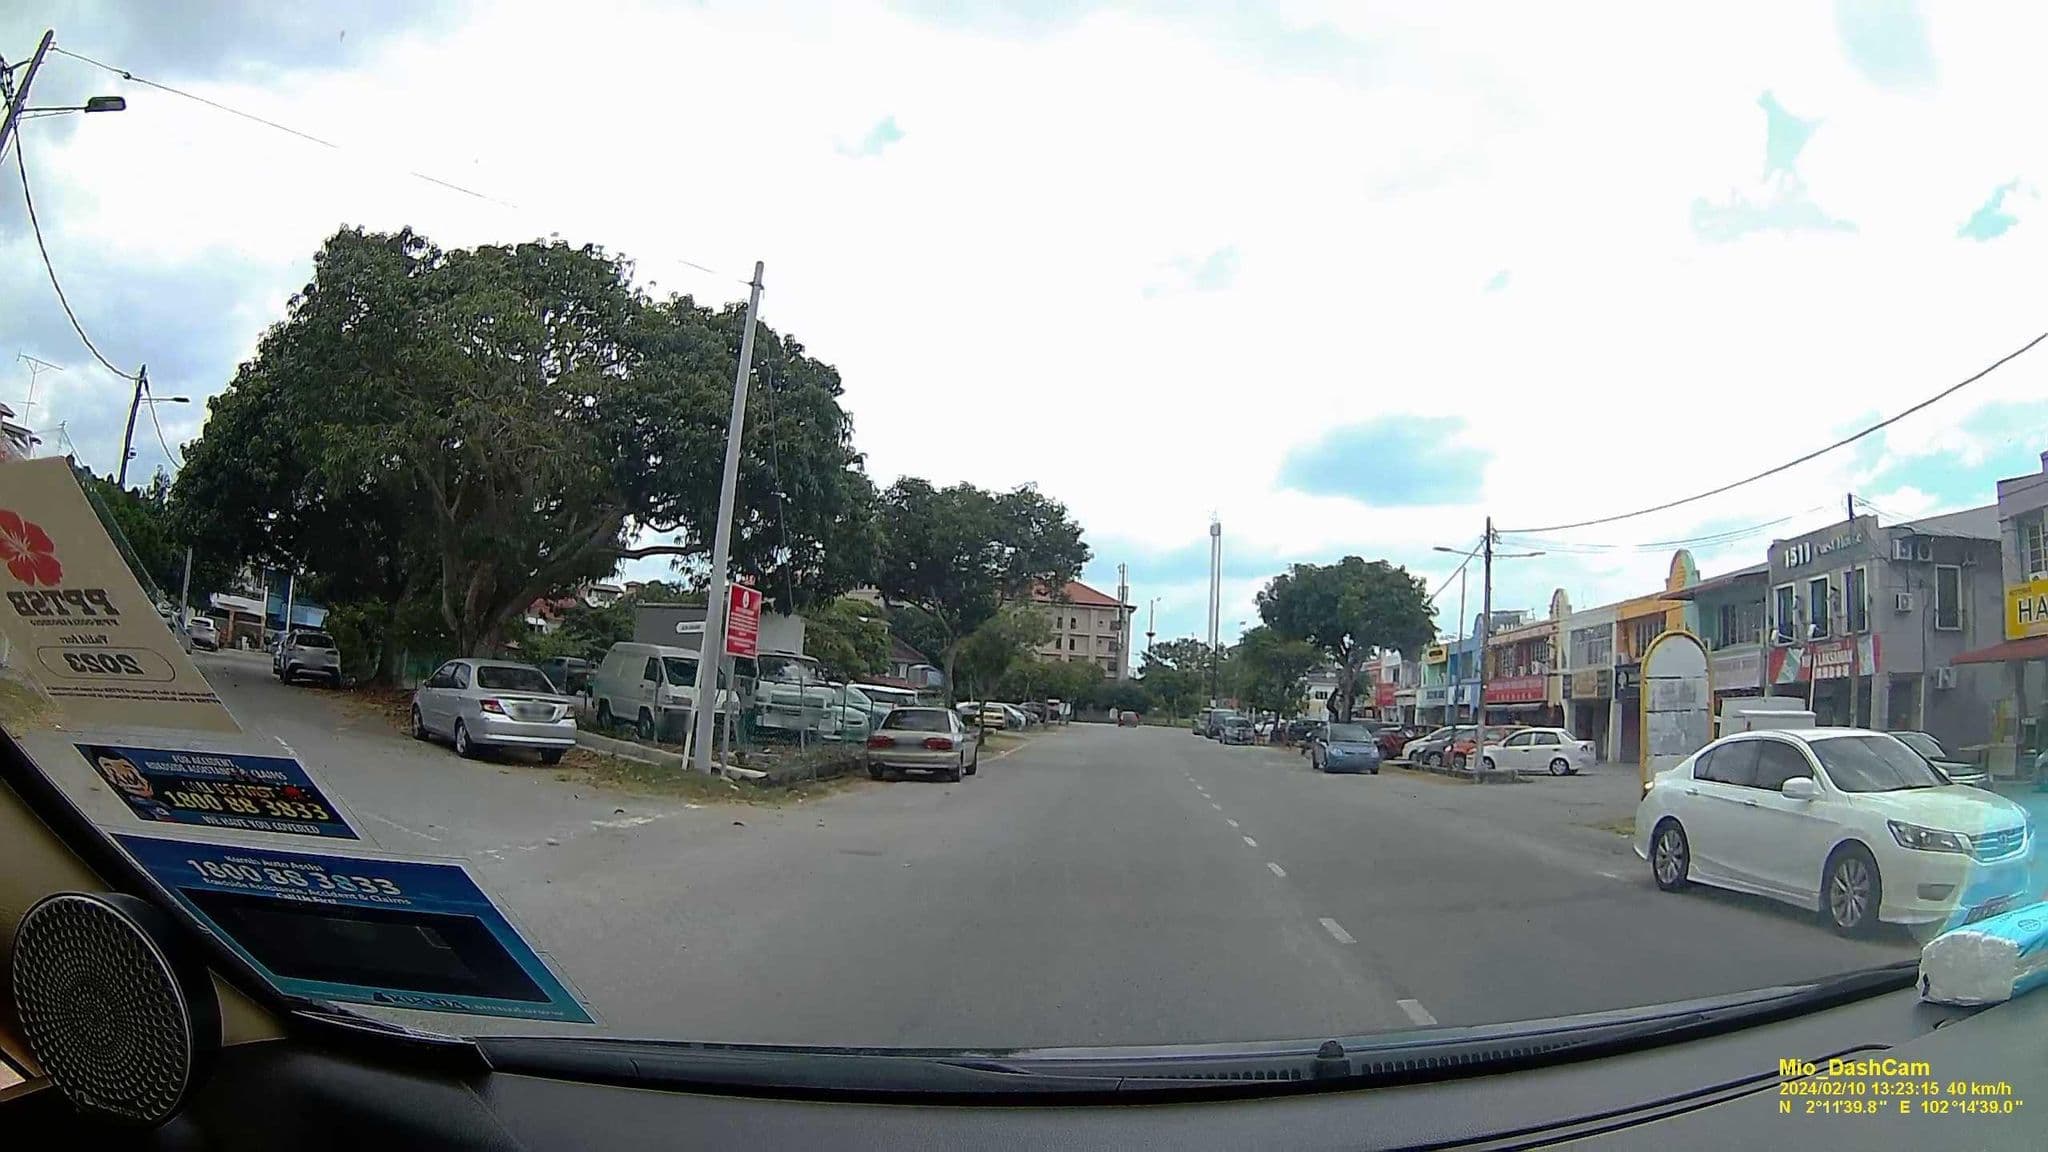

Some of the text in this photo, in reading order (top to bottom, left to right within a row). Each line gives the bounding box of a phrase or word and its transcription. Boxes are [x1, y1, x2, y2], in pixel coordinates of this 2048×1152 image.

[212, 782, 235, 795] US
[165, 791, 329, 820] 1800 88 3833
[202, 815, 320, 834] WE HAVE YOU COVERED
[187, 859, 401, 895] 1800 88 3833
